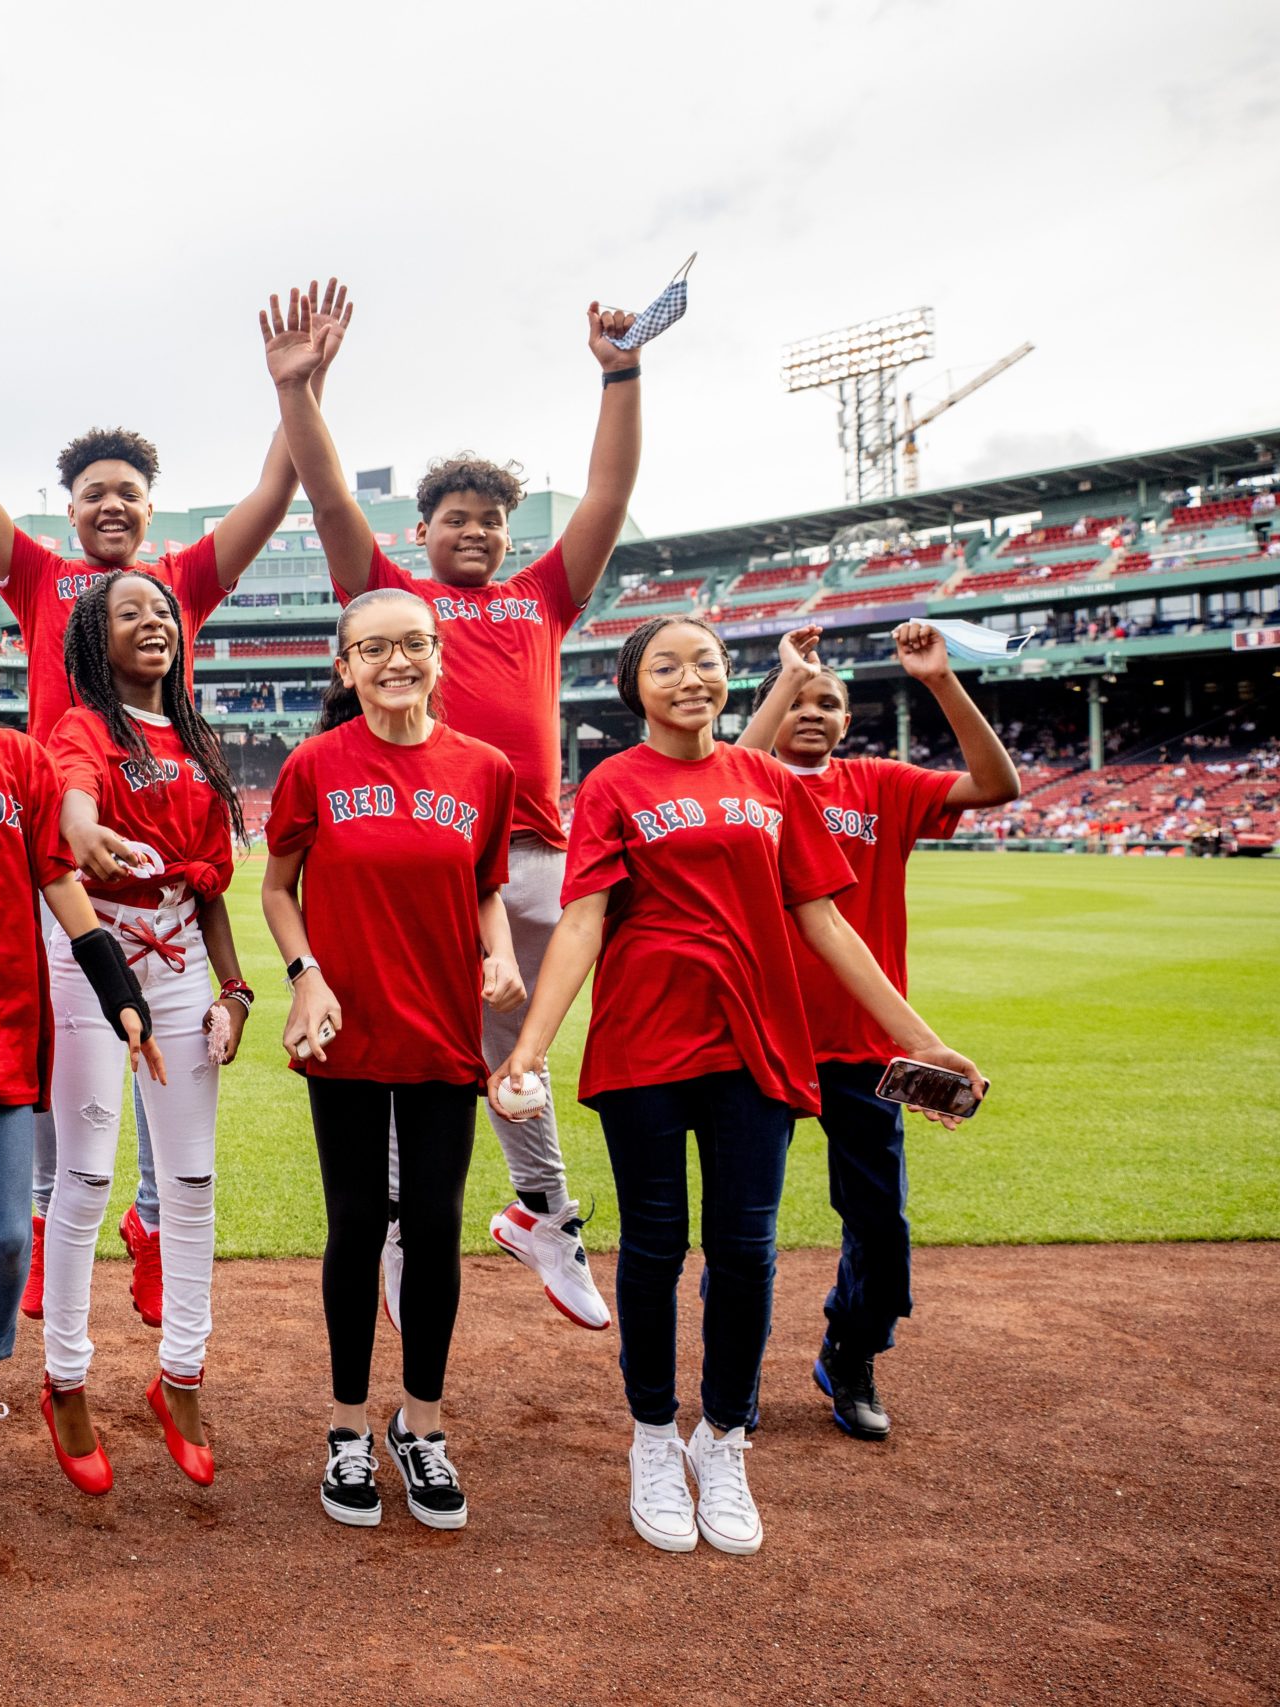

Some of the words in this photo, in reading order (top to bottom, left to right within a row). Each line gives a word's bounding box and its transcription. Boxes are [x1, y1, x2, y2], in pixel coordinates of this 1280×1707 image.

[486, 597, 543, 623] SOX
[327, 784, 396, 824] RED
[412, 789, 479, 838] SOX
[632, 798, 706, 843] RED
[719, 797, 783, 845] SOX
[823, 806, 879, 842] SOX
